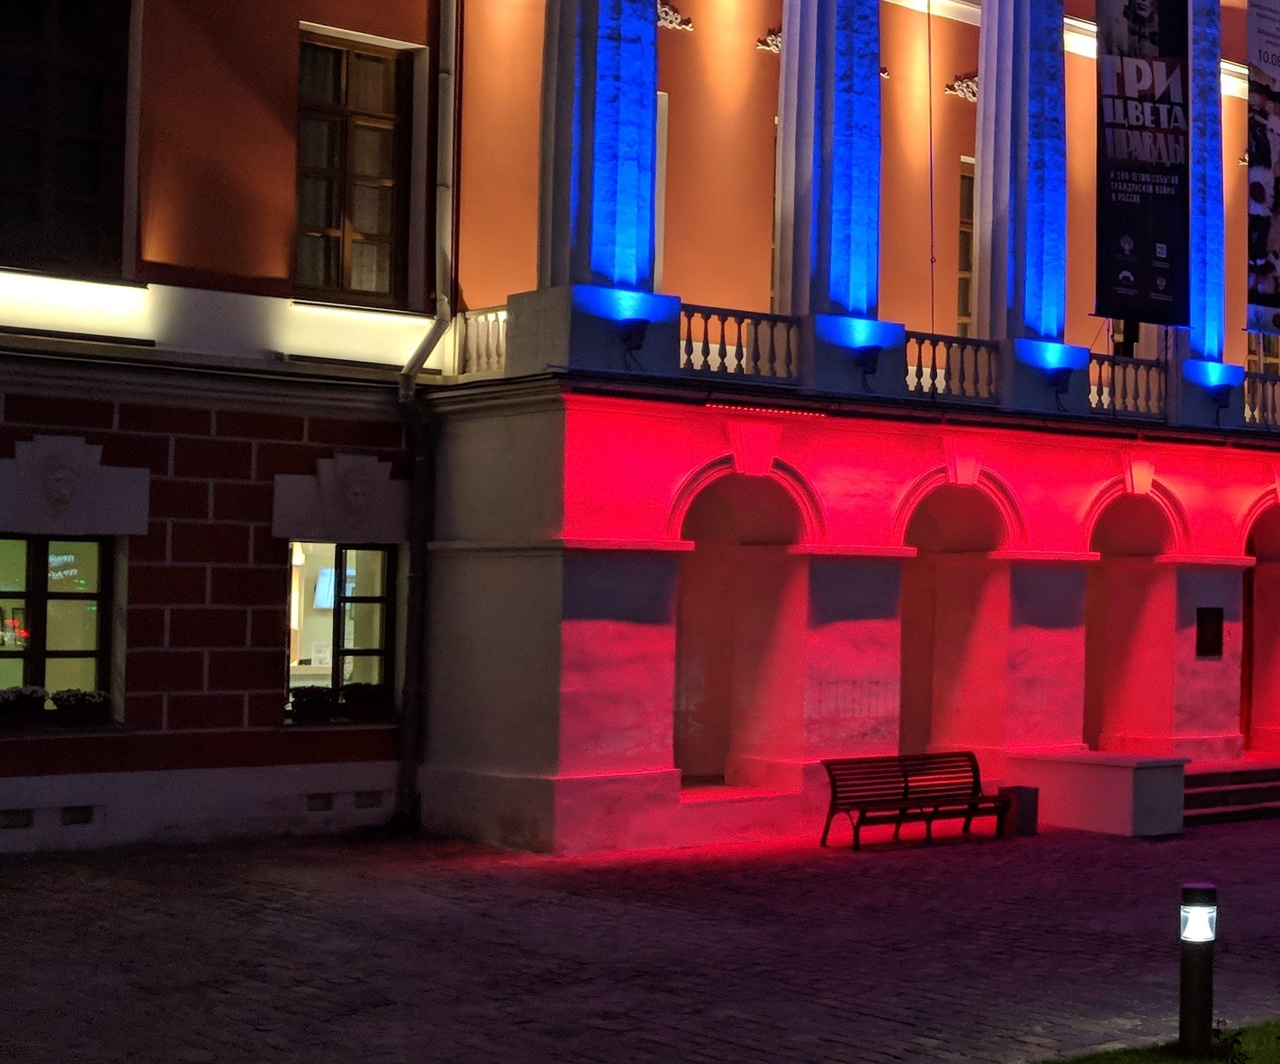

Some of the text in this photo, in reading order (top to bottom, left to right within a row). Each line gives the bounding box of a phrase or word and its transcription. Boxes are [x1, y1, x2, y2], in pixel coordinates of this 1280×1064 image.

[1099, 55, 1184, 104] ТРИ
[1102, 97, 1188, 131] ЦВЕТА
[1105, 127, 1186, 168] ПРАВДЫ
